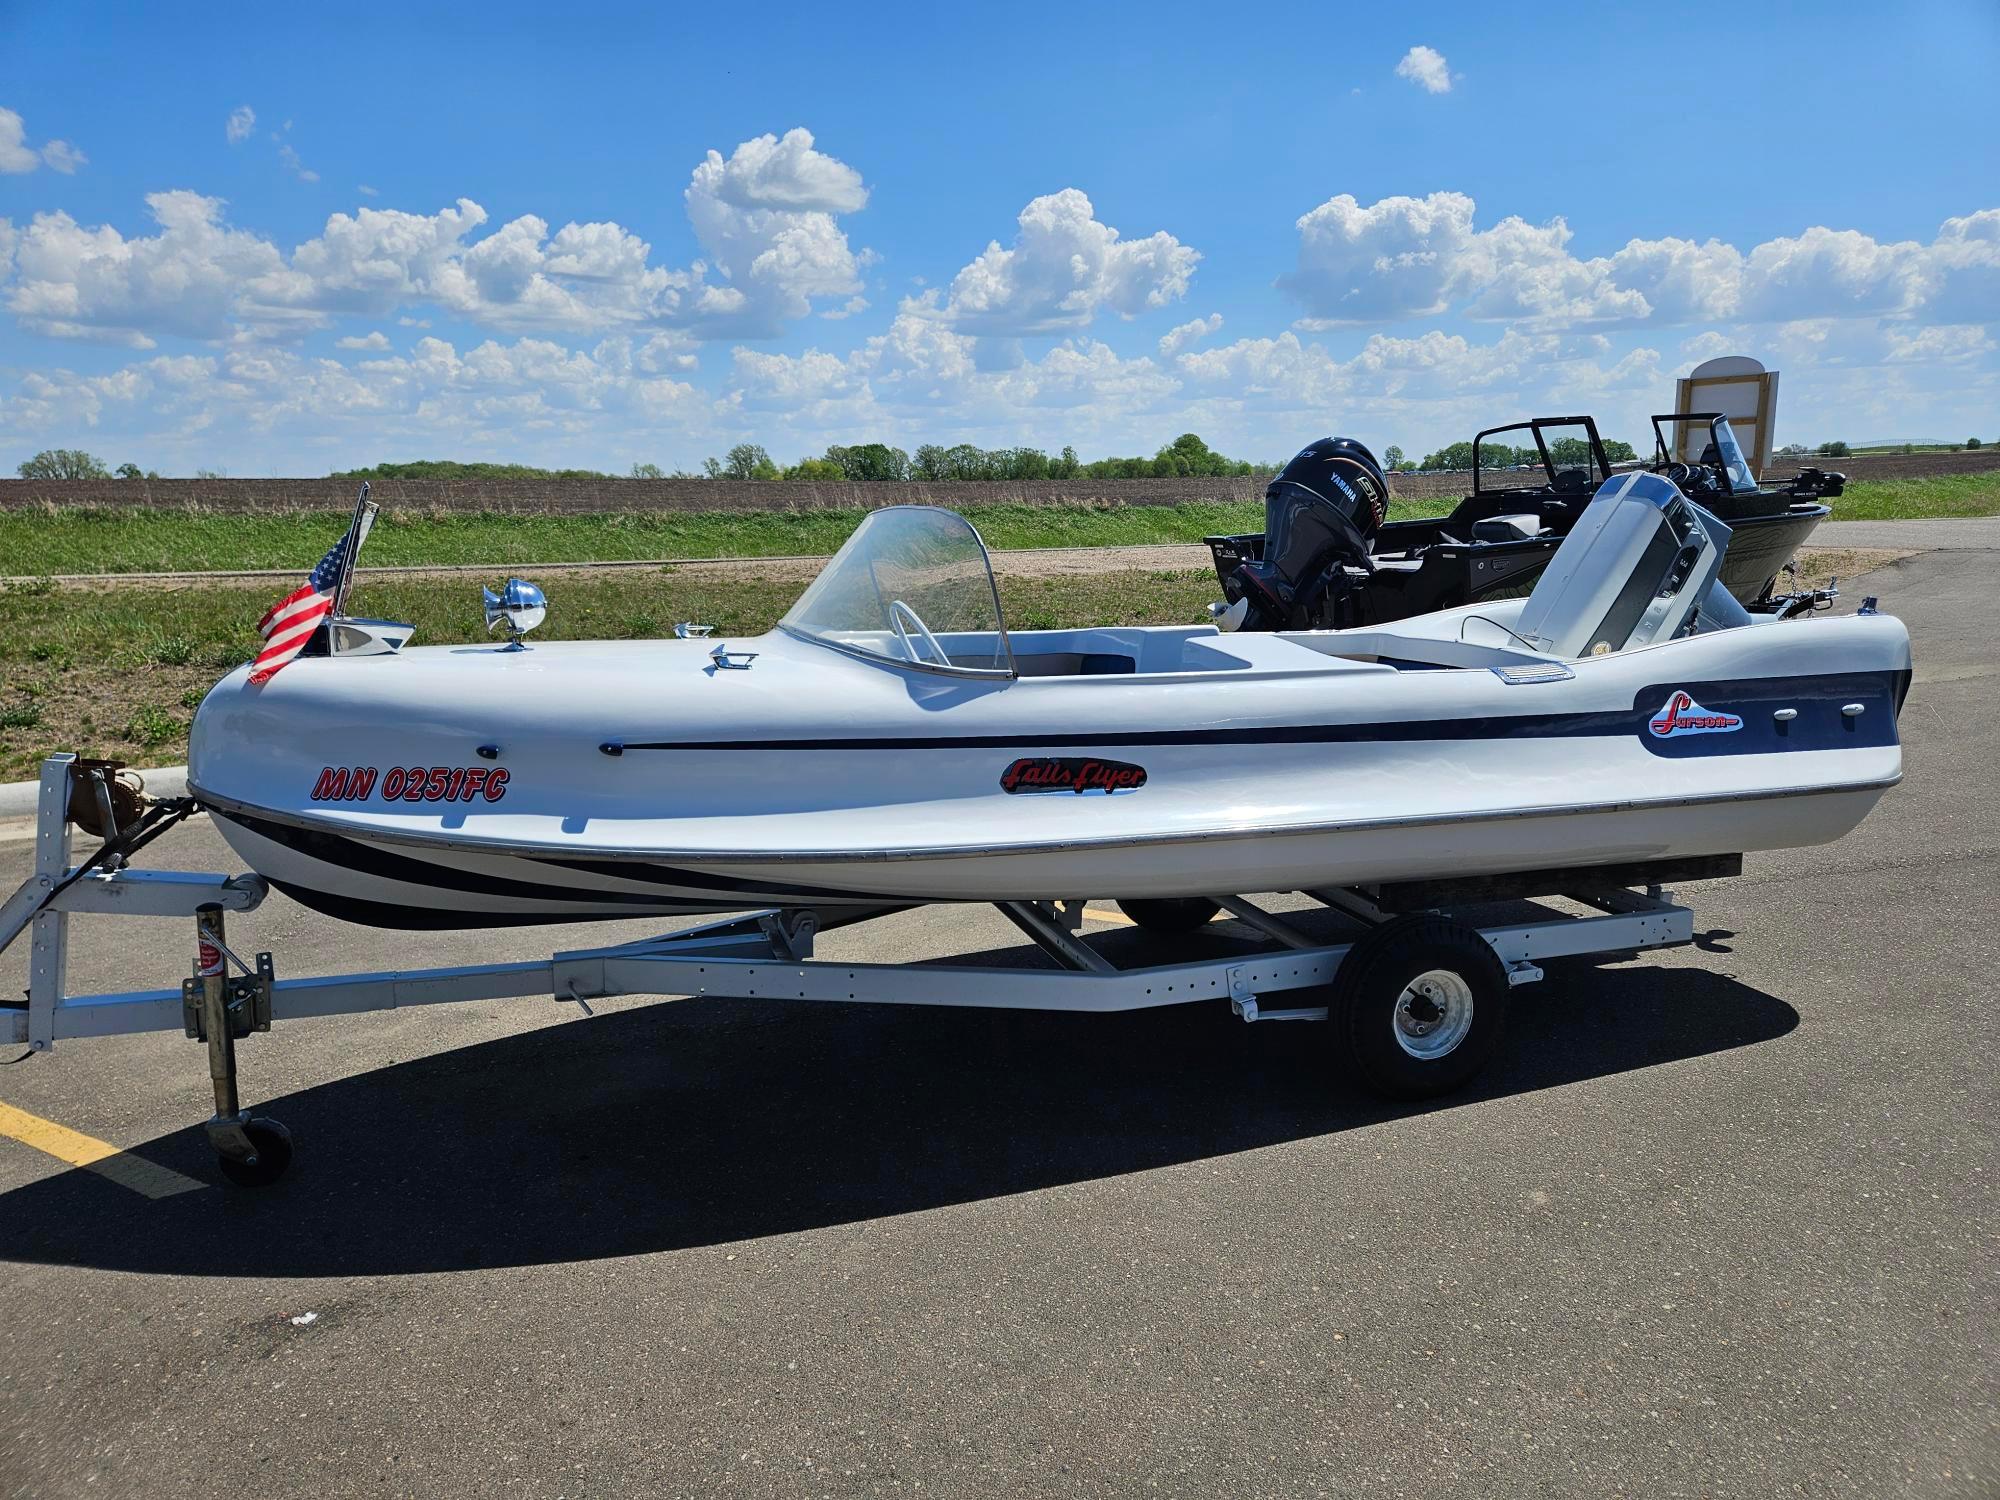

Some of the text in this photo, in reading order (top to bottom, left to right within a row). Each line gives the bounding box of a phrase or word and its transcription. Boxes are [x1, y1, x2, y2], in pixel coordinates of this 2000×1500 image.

[1331, 472, 1356, 502] YAMAHA
[1651, 693, 1739, 735] Larson
[310, 766, 511, 802] MN 0251FC
[1003, 760, 1146, 794] Falls Flyer
